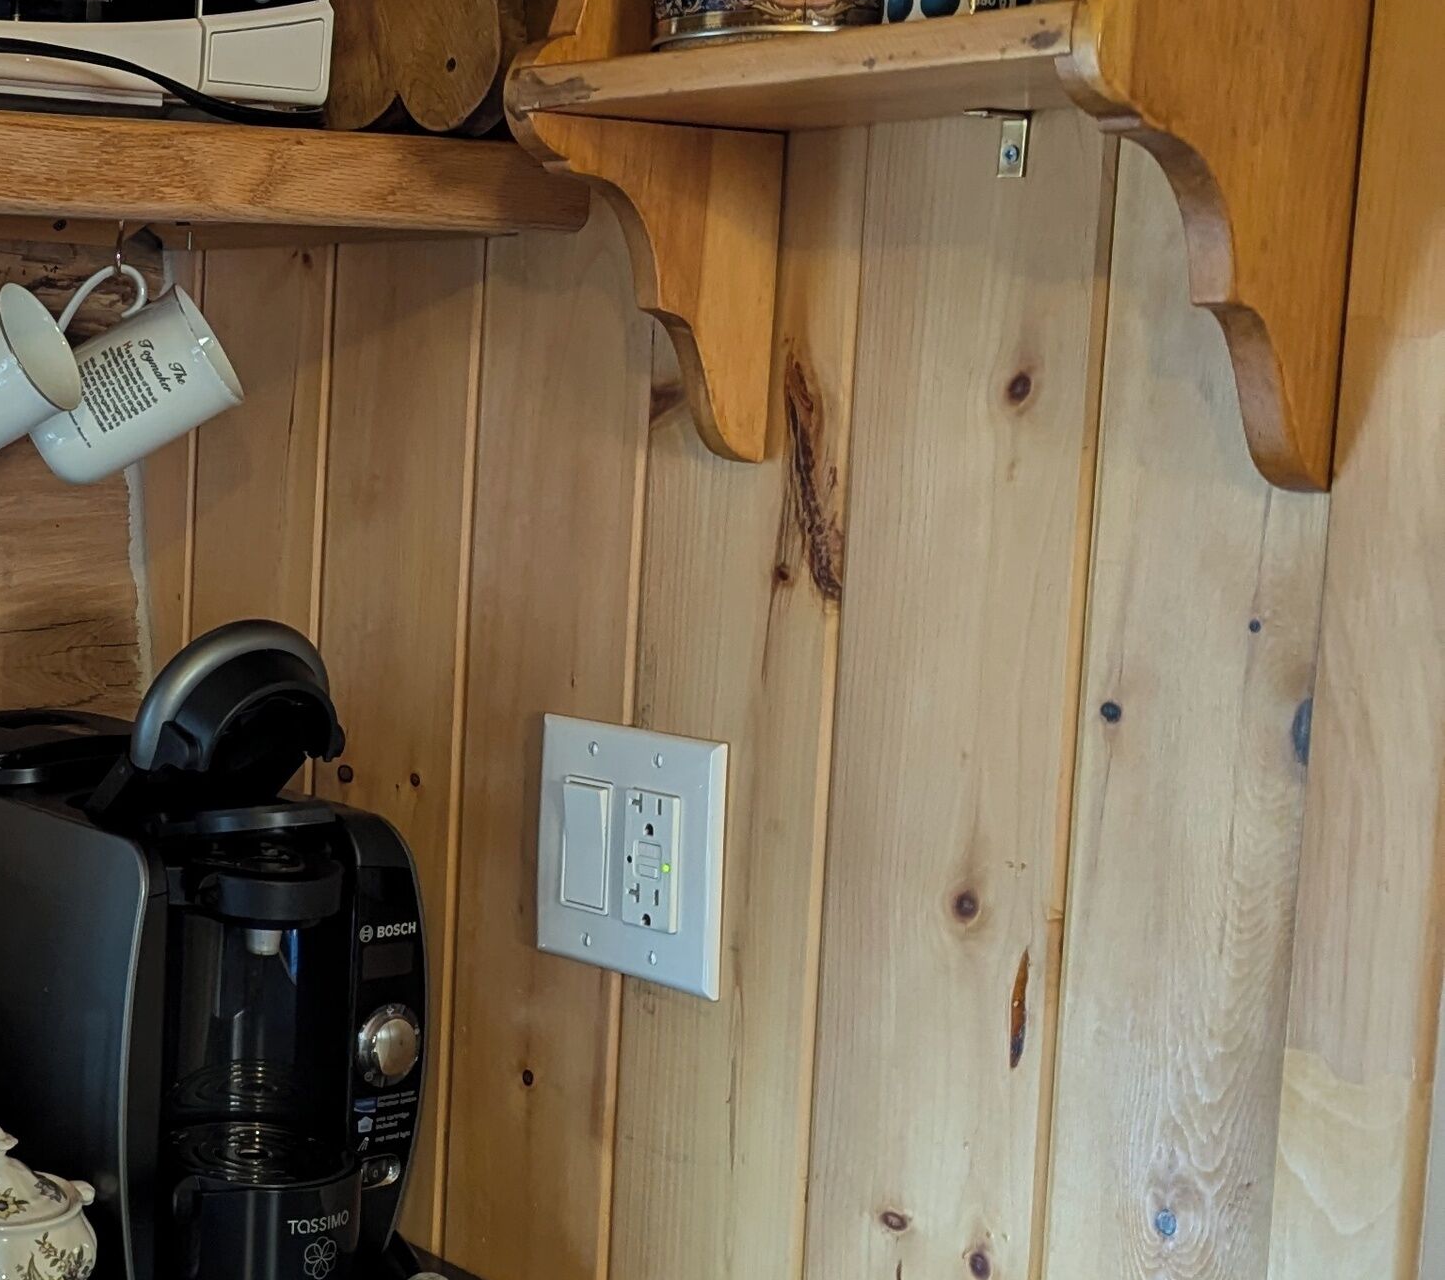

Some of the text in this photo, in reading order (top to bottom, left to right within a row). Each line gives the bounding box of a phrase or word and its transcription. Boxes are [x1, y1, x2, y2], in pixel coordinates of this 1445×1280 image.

[122, 359, 137, 385] because
[134, 366, 143, 380] hero
[137, 338, 170, 391] Toymaker
[168, 362, 187, 384] The
[111, 386, 123, 403] wood
[136, 400, 146, 411] and
[376, 921, 417, 939] BOSCH
[287, 1210, 349, 1235] TASSIMO
